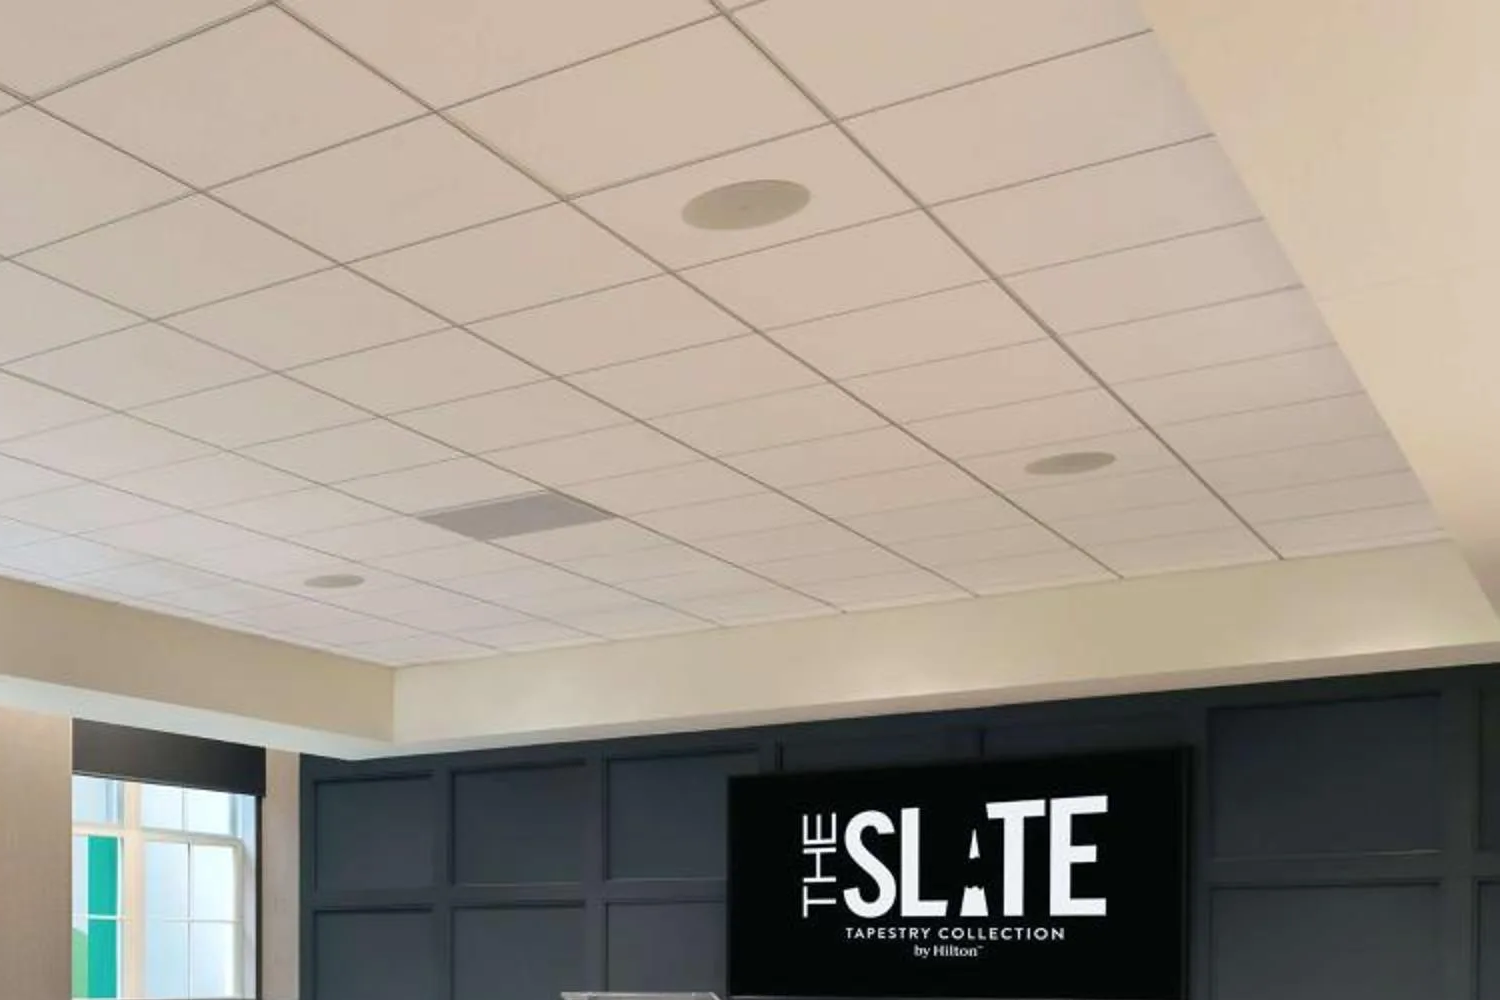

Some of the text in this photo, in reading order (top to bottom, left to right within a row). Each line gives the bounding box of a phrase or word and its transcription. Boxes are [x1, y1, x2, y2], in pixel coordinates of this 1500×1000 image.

[802, 812, 837, 918] THE
[843, 795, 1108, 918] SLATE
[845, 927, 1066, 941] TAPESTRY COLLECTION
[913, 944, 931, 958] by
